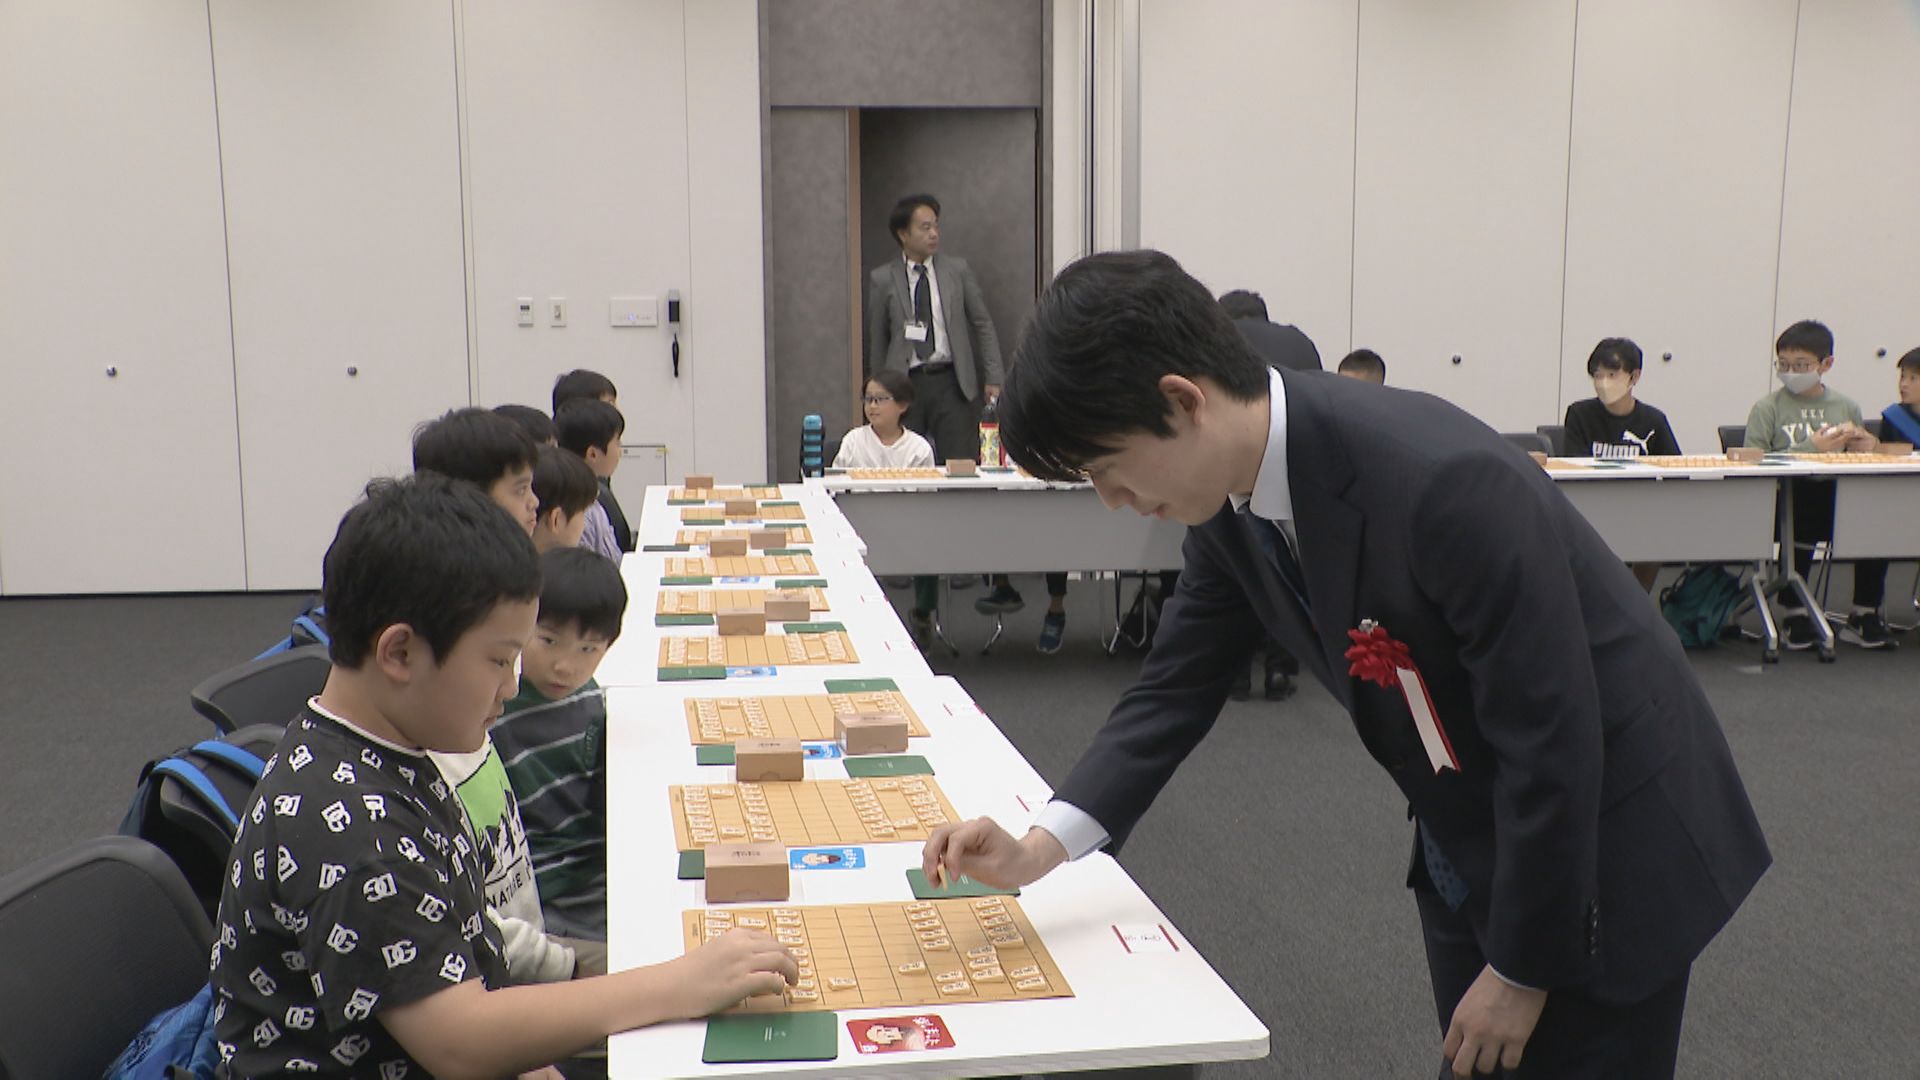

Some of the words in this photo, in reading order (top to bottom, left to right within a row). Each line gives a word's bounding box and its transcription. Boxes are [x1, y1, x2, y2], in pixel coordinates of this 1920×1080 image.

[486, 872, 523, 909] NATE
[415, 892, 448, 923] DG
[326, 922, 359, 954] DG
[381, 940, 417, 969] DG
[438, 952, 468, 985] DG
[248, 966, 277, 997] DG
[284, 1005, 316, 1031] DG
